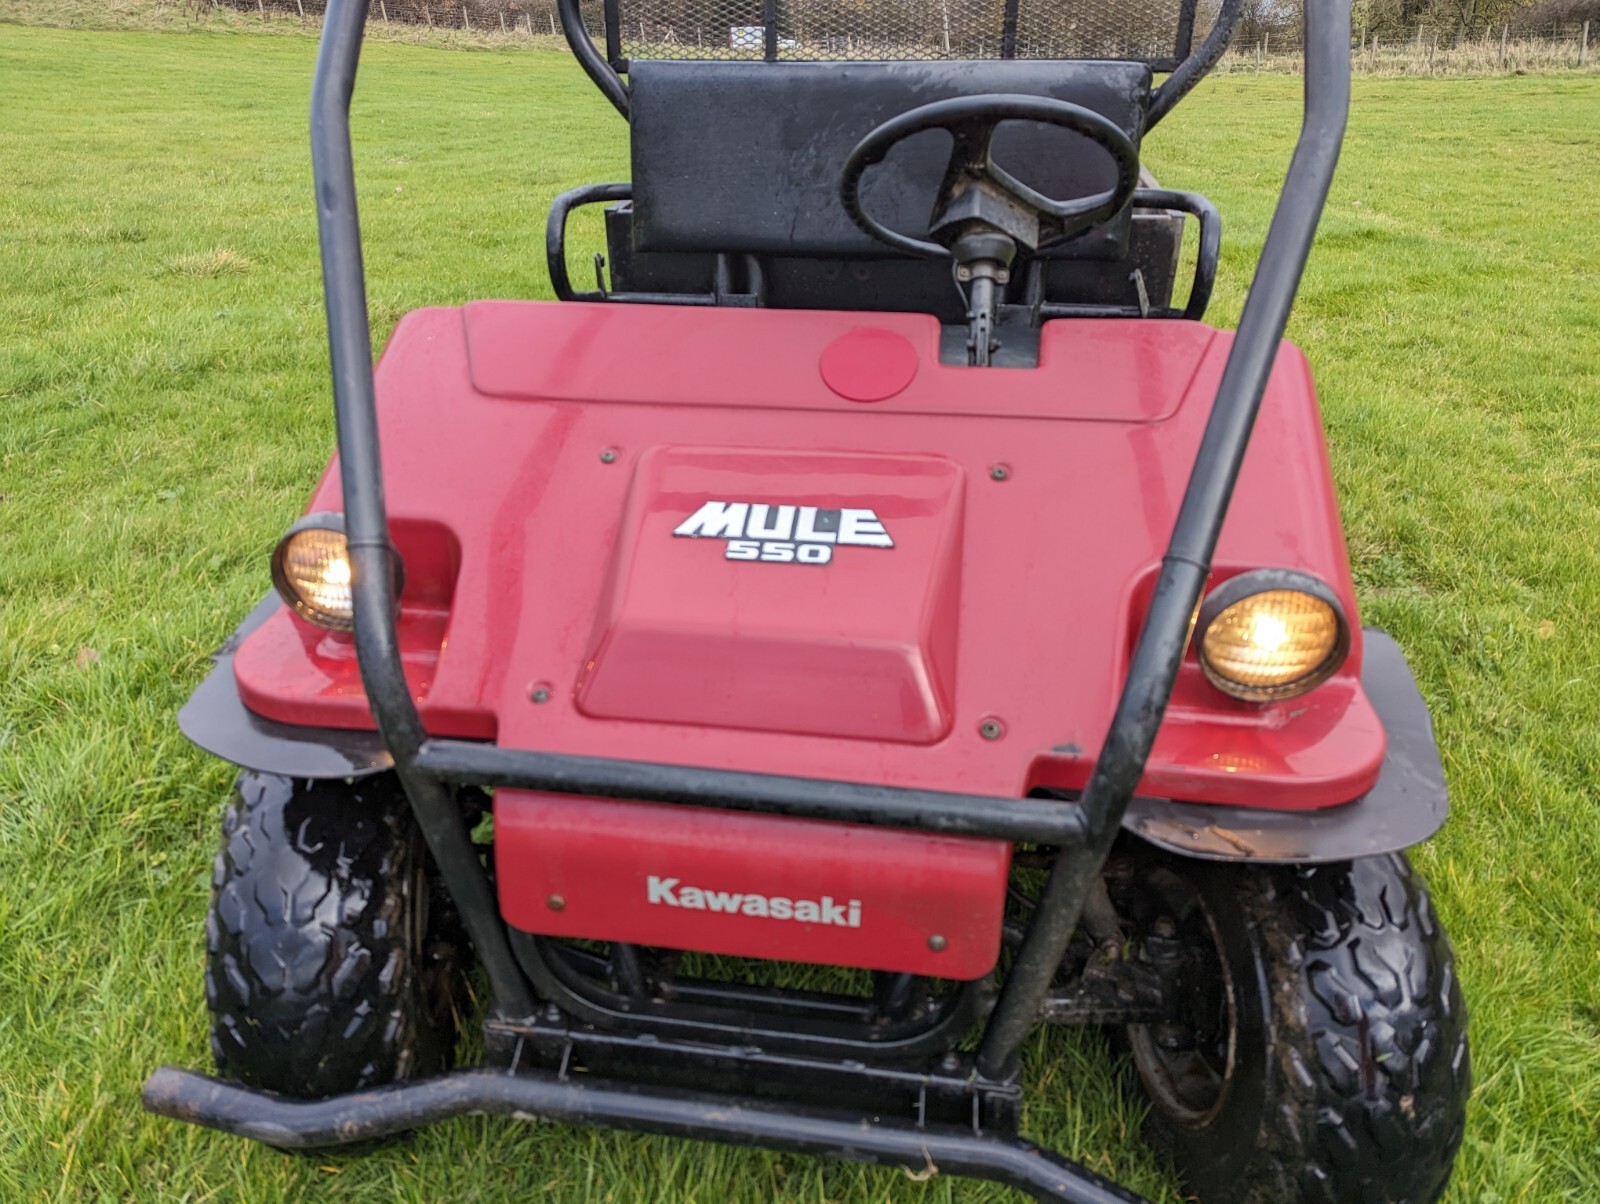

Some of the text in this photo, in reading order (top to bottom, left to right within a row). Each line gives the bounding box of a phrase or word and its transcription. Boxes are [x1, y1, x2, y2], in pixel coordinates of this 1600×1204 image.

[672, 500, 895, 548] MULE
[725, 540, 832, 564] 550
[647, 875, 862, 928] Kawasaki
